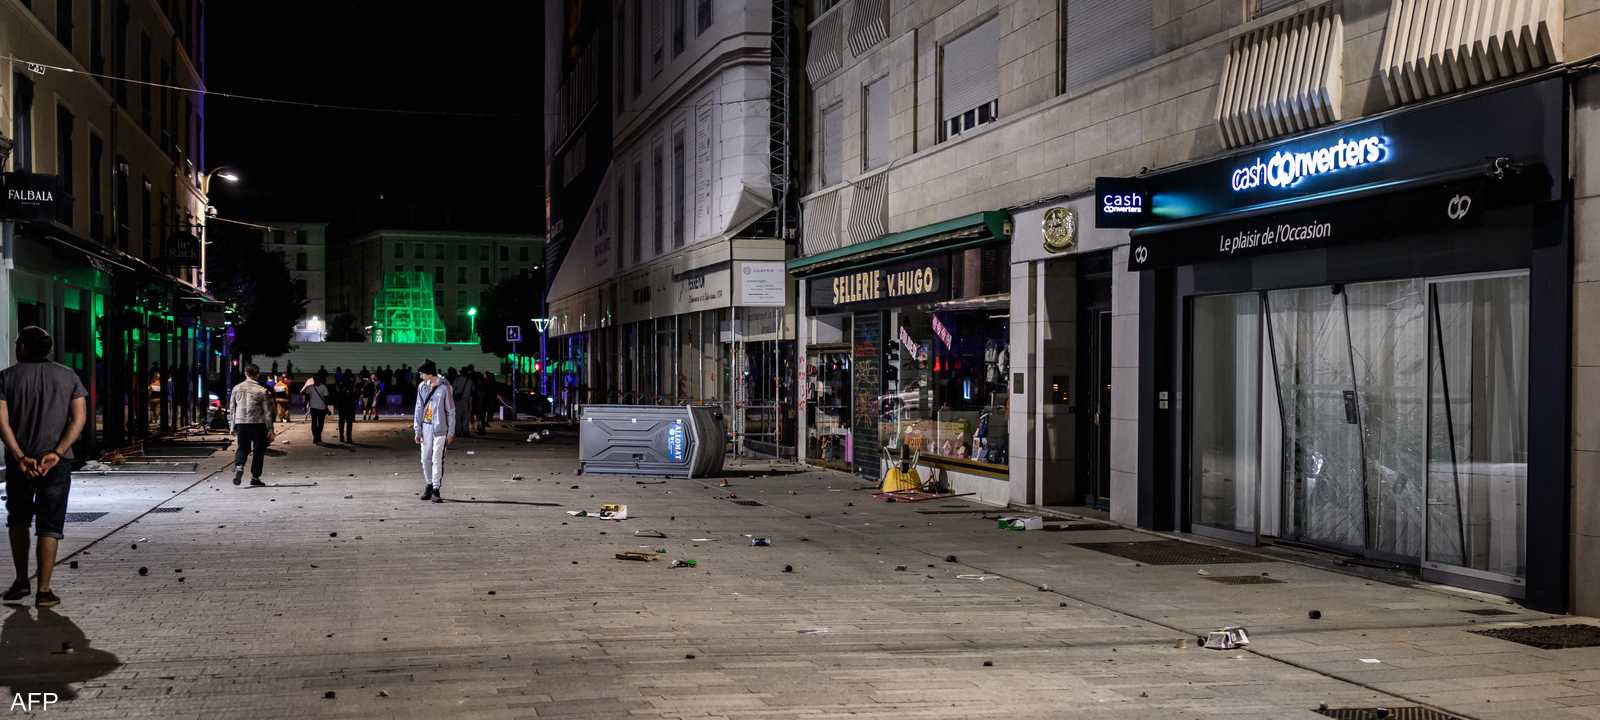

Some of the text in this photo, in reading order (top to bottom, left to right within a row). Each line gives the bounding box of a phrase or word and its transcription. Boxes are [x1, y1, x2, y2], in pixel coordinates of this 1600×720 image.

[1232, 157, 1267, 191] cash
[8, 189, 54, 202] FALBALA
[1103, 192, 1142, 206] cash
[1219, 220, 1331, 254] Le plaisir de l'Occasion
[833, 269, 881, 305] SELLERIE
